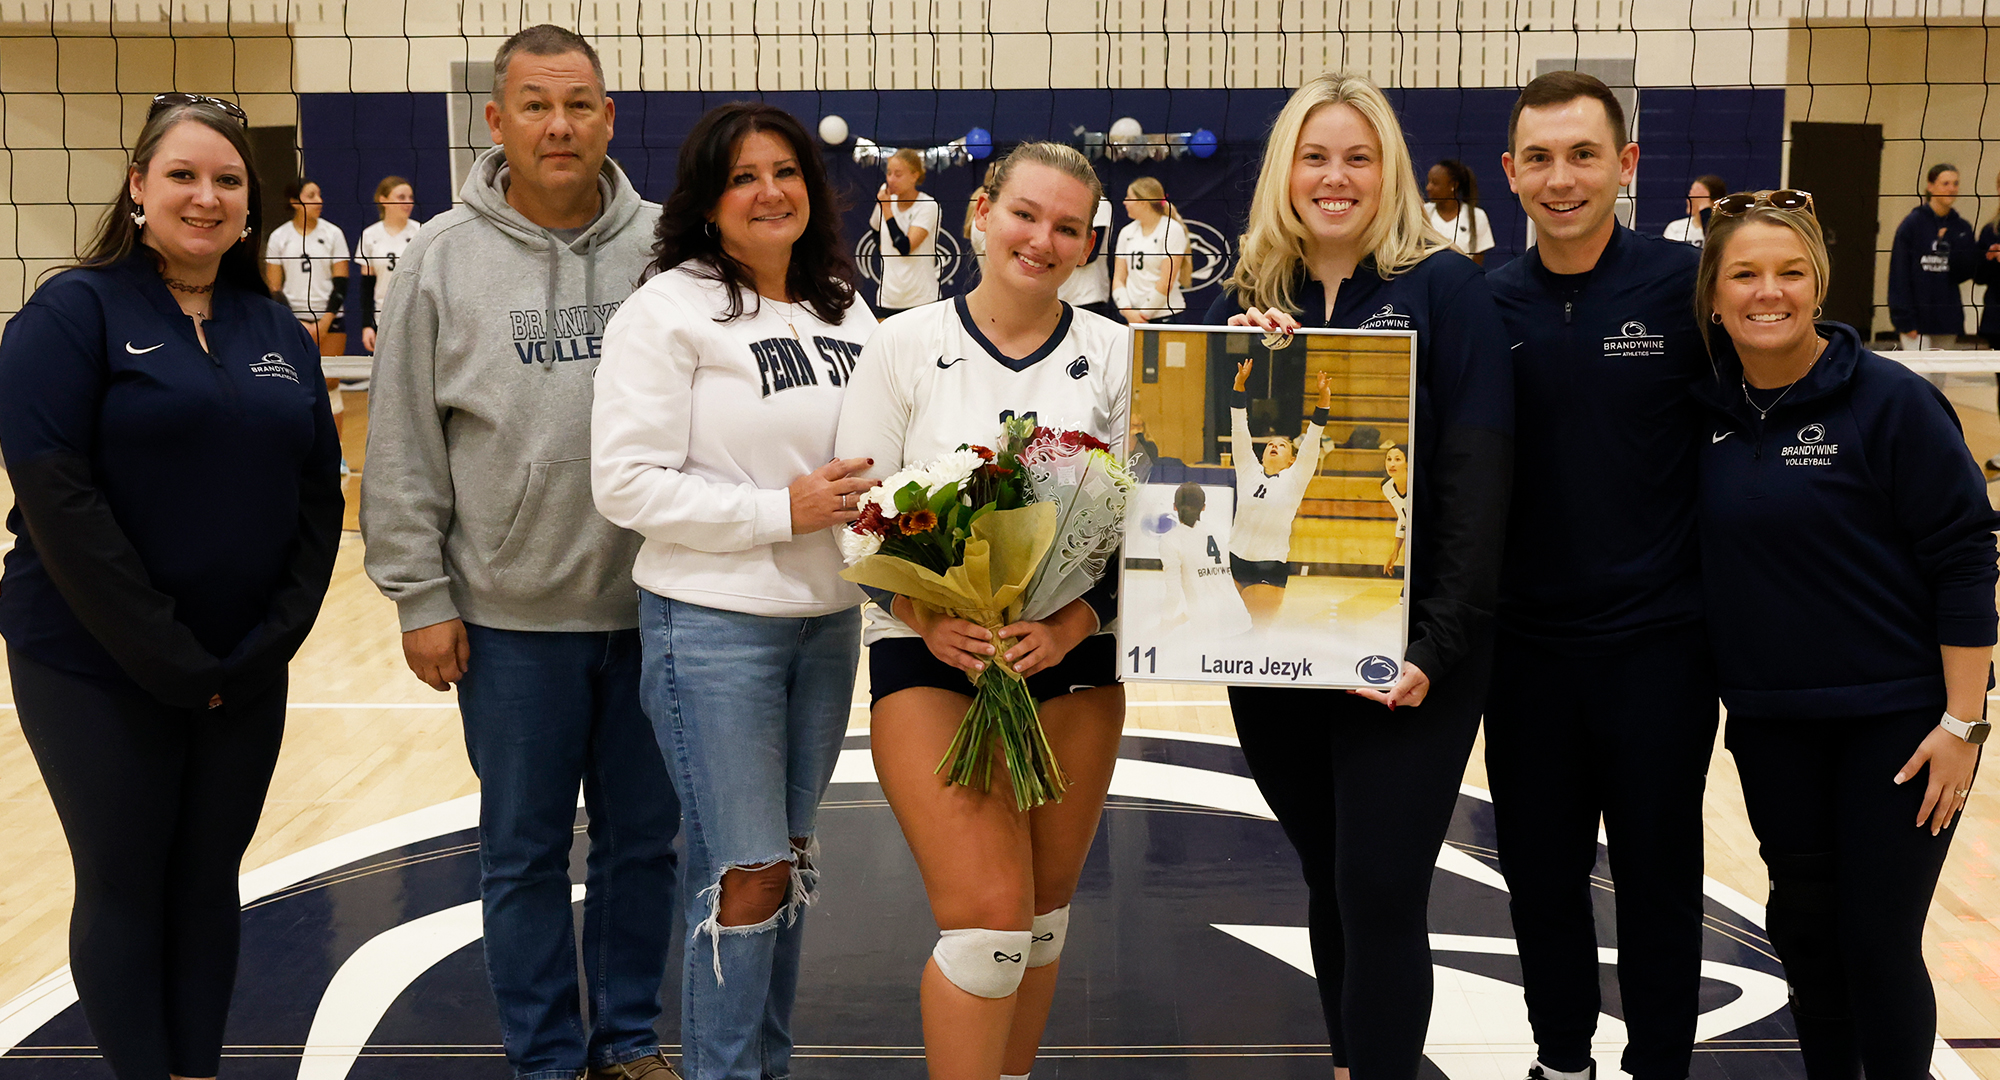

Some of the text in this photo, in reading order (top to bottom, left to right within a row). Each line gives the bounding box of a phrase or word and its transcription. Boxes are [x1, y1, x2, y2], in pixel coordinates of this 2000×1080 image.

[386, 252, 396, 272] 3
[1131, 250, 1144, 270] 13
[1603, 340, 1664, 351] BRANDYWINE
[749, 337, 819, 399] PENN
[1781, 444, 1838, 457] BRANDYWINE
[1785, 457, 1832, 466] VOLLEYBALL
[1253, 484, 1267, 499] 11
[1206, 535, 1222, 565] 4
[1128, 646, 1156, 674] 11
[1201, 654, 1313, 681] Laura Jezyk
